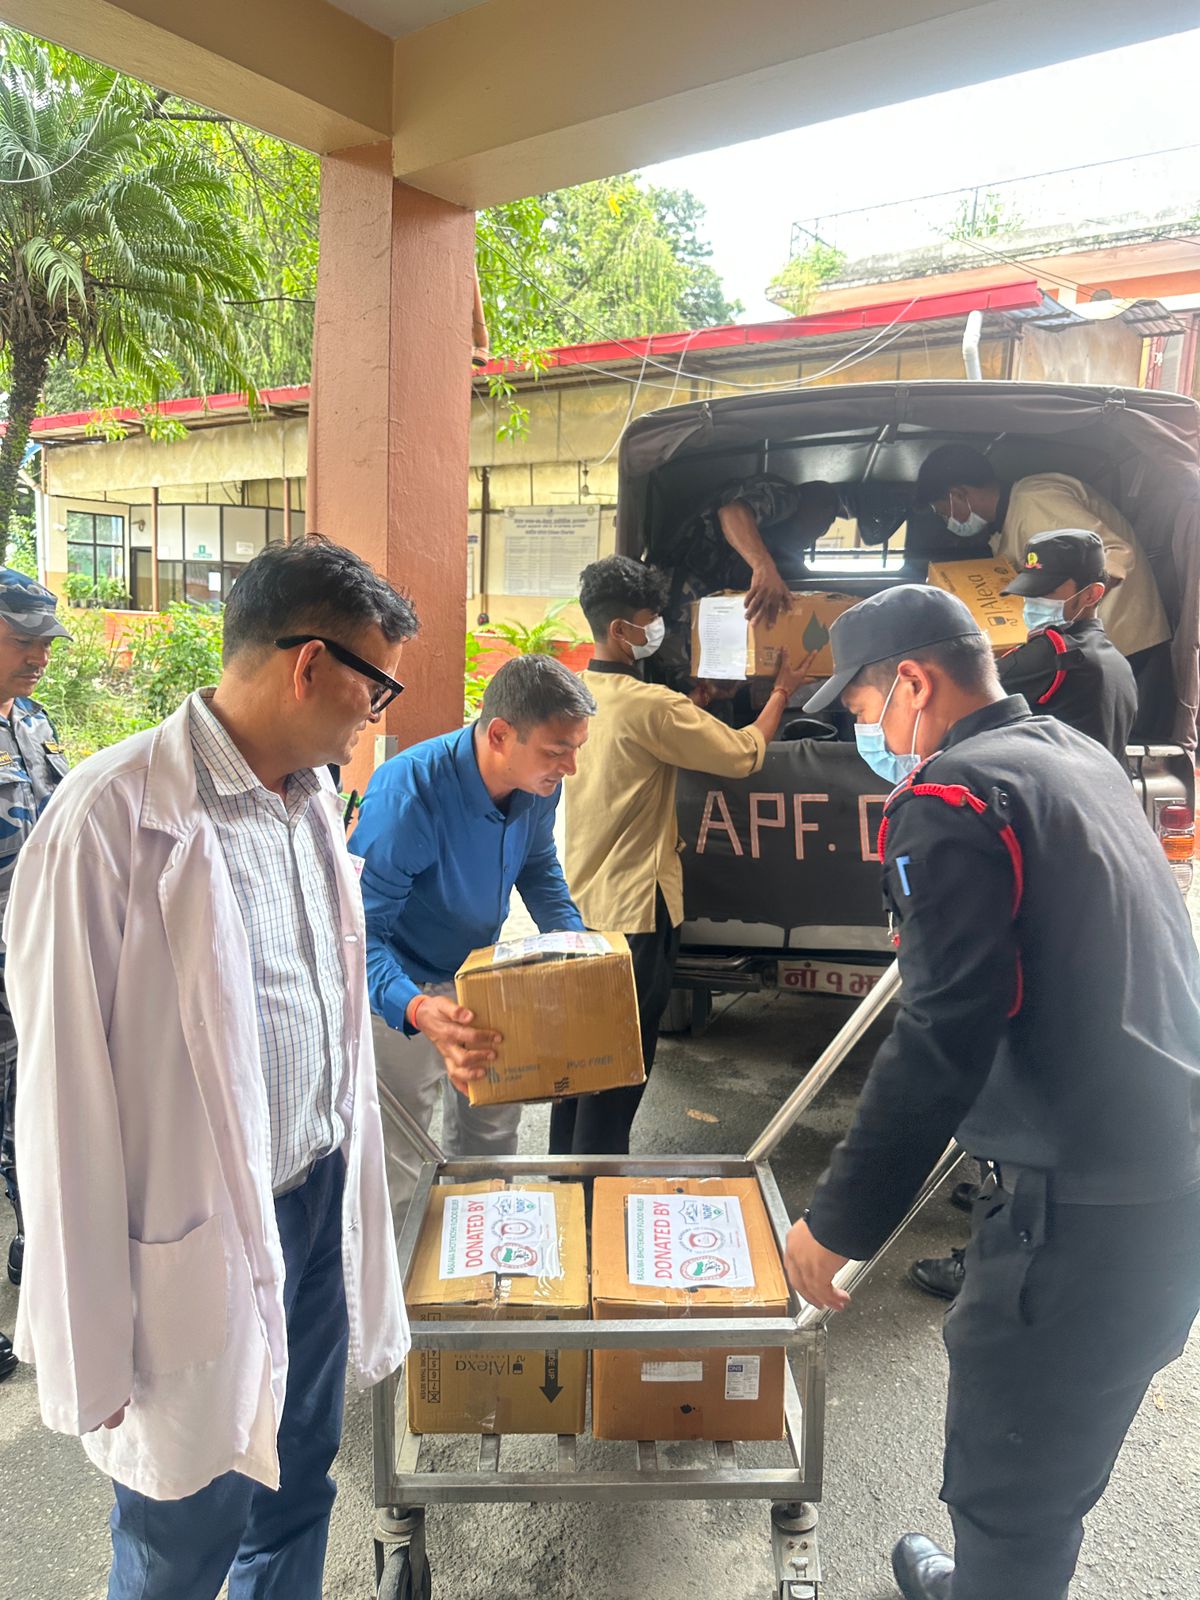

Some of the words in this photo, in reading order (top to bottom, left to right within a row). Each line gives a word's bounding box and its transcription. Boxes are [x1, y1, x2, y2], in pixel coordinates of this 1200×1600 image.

[968, 574, 1002, 610] Alexa
[695, 790, 837, 860] APF.
[467, 1200, 484, 1212] BY
[653, 1201, 670, 1216] BY
[465, 1214, 484, 1268] DONATED
[654, 1219, 672, 1279] DONATED
[455, 1360, 506, 1376] Alexa
